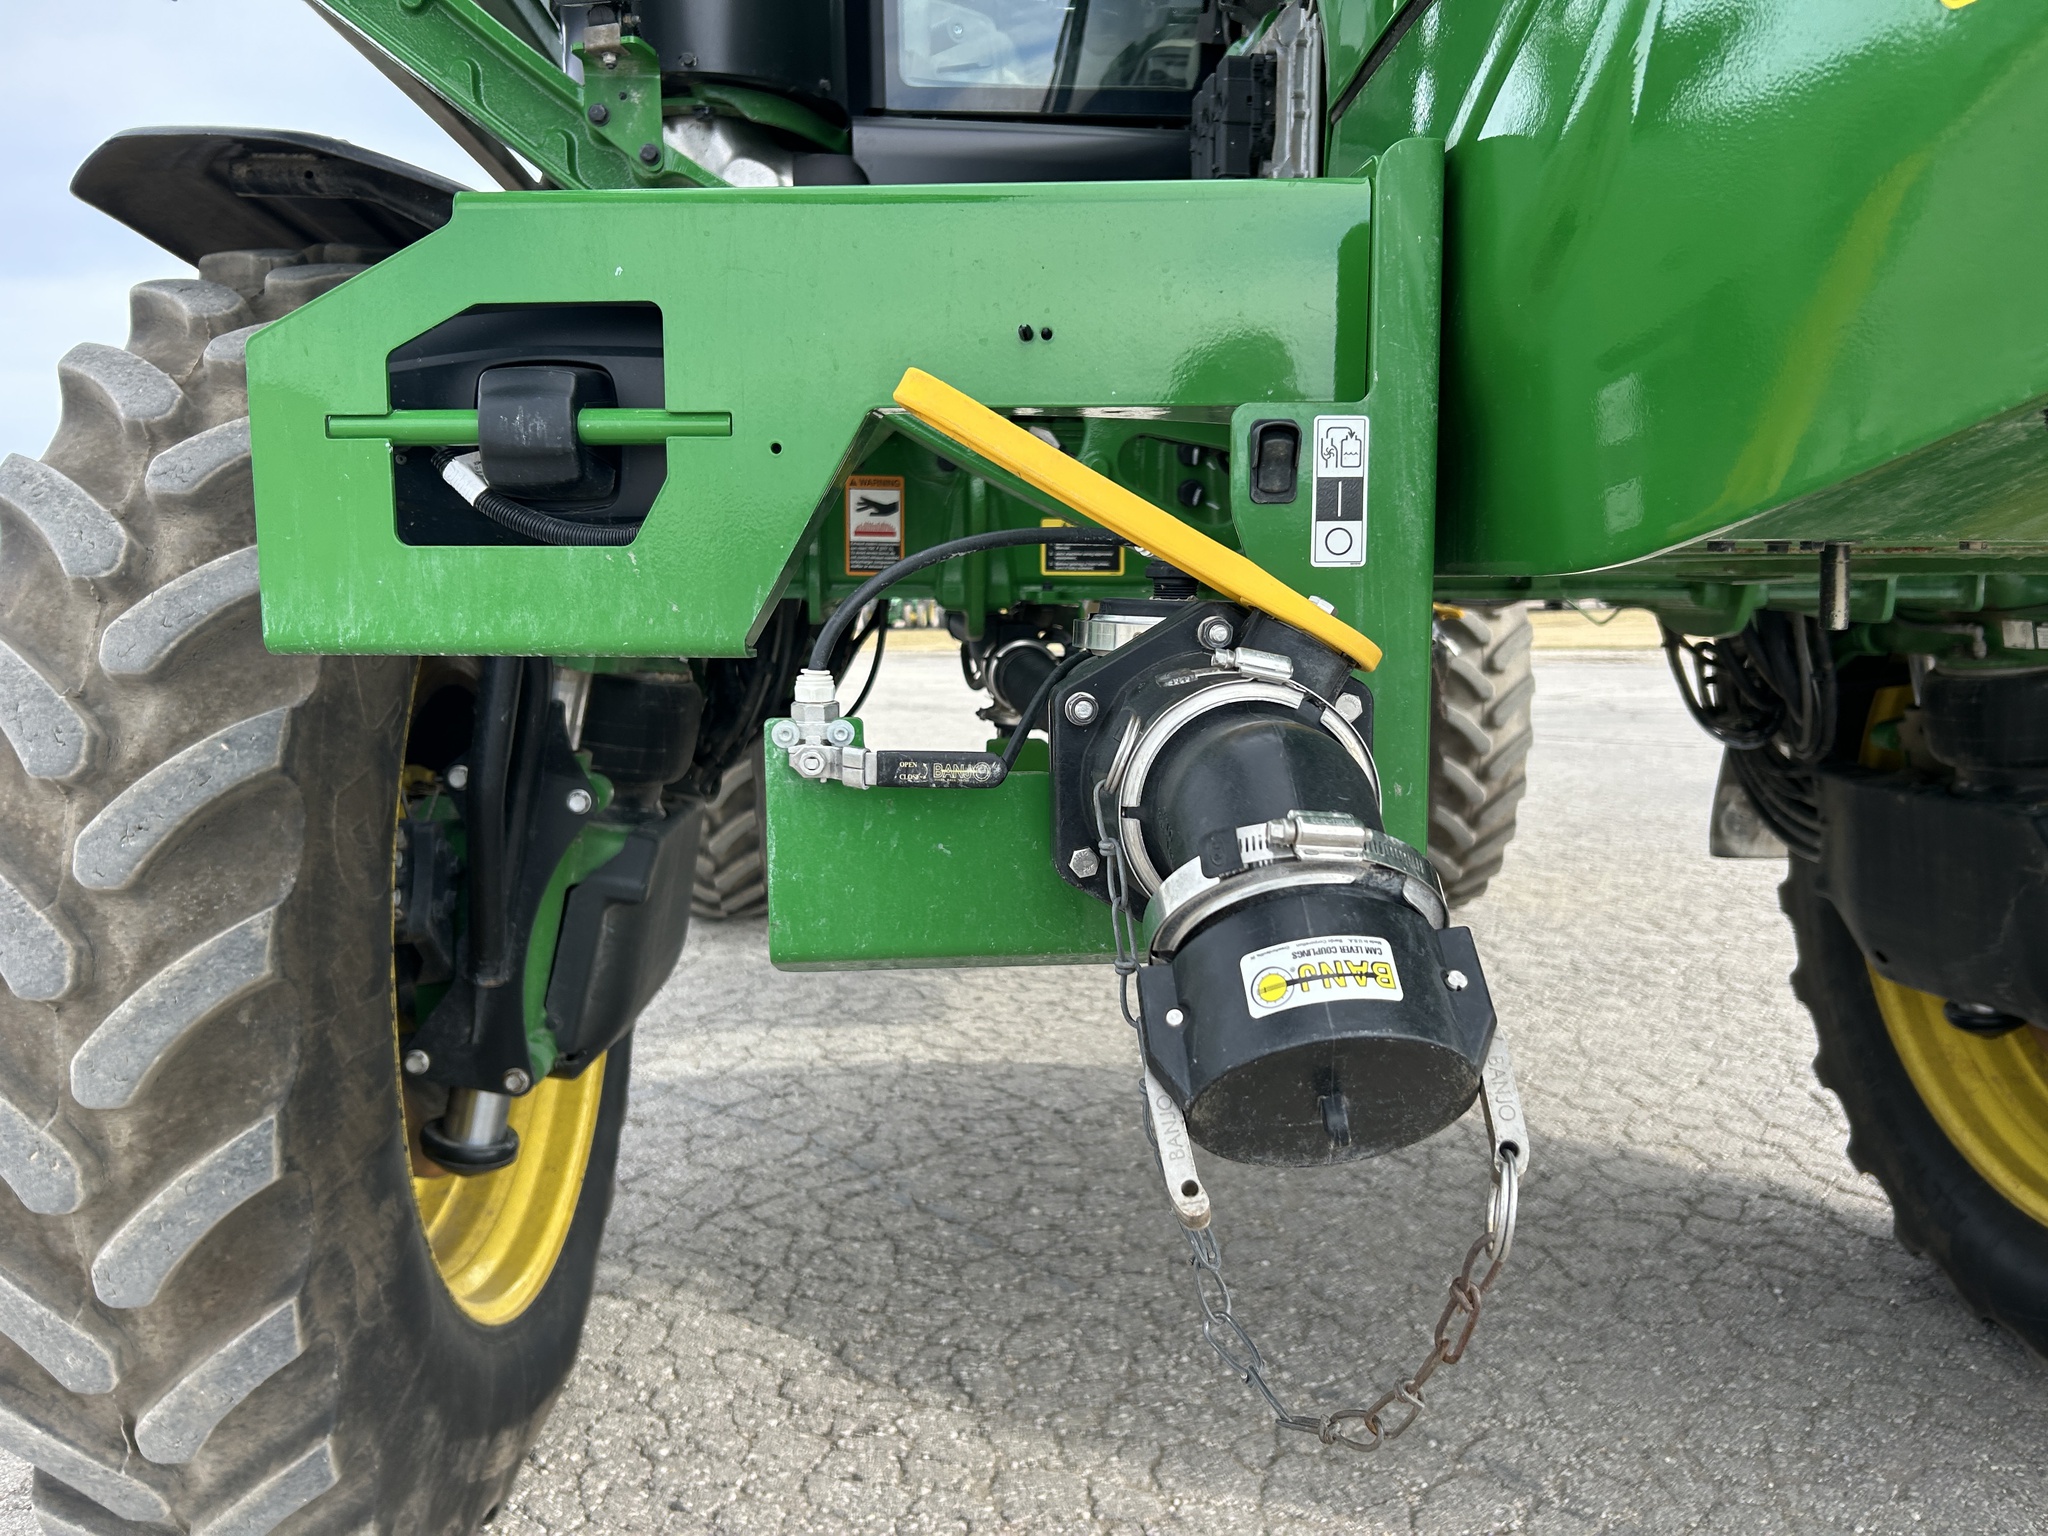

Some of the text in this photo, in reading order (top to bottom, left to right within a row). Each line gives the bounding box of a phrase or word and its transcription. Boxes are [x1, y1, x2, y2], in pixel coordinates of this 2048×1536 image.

[859, 479, 900, 488] WARNING
[933, 761, 992, 782] BANJO
[1291, 945, 1383, 960] CAM LEVER COUPLINGS
[1487, 1055, 1517, 1122] BANJO
[1156, 1094, 1186, 1161] BANJO
